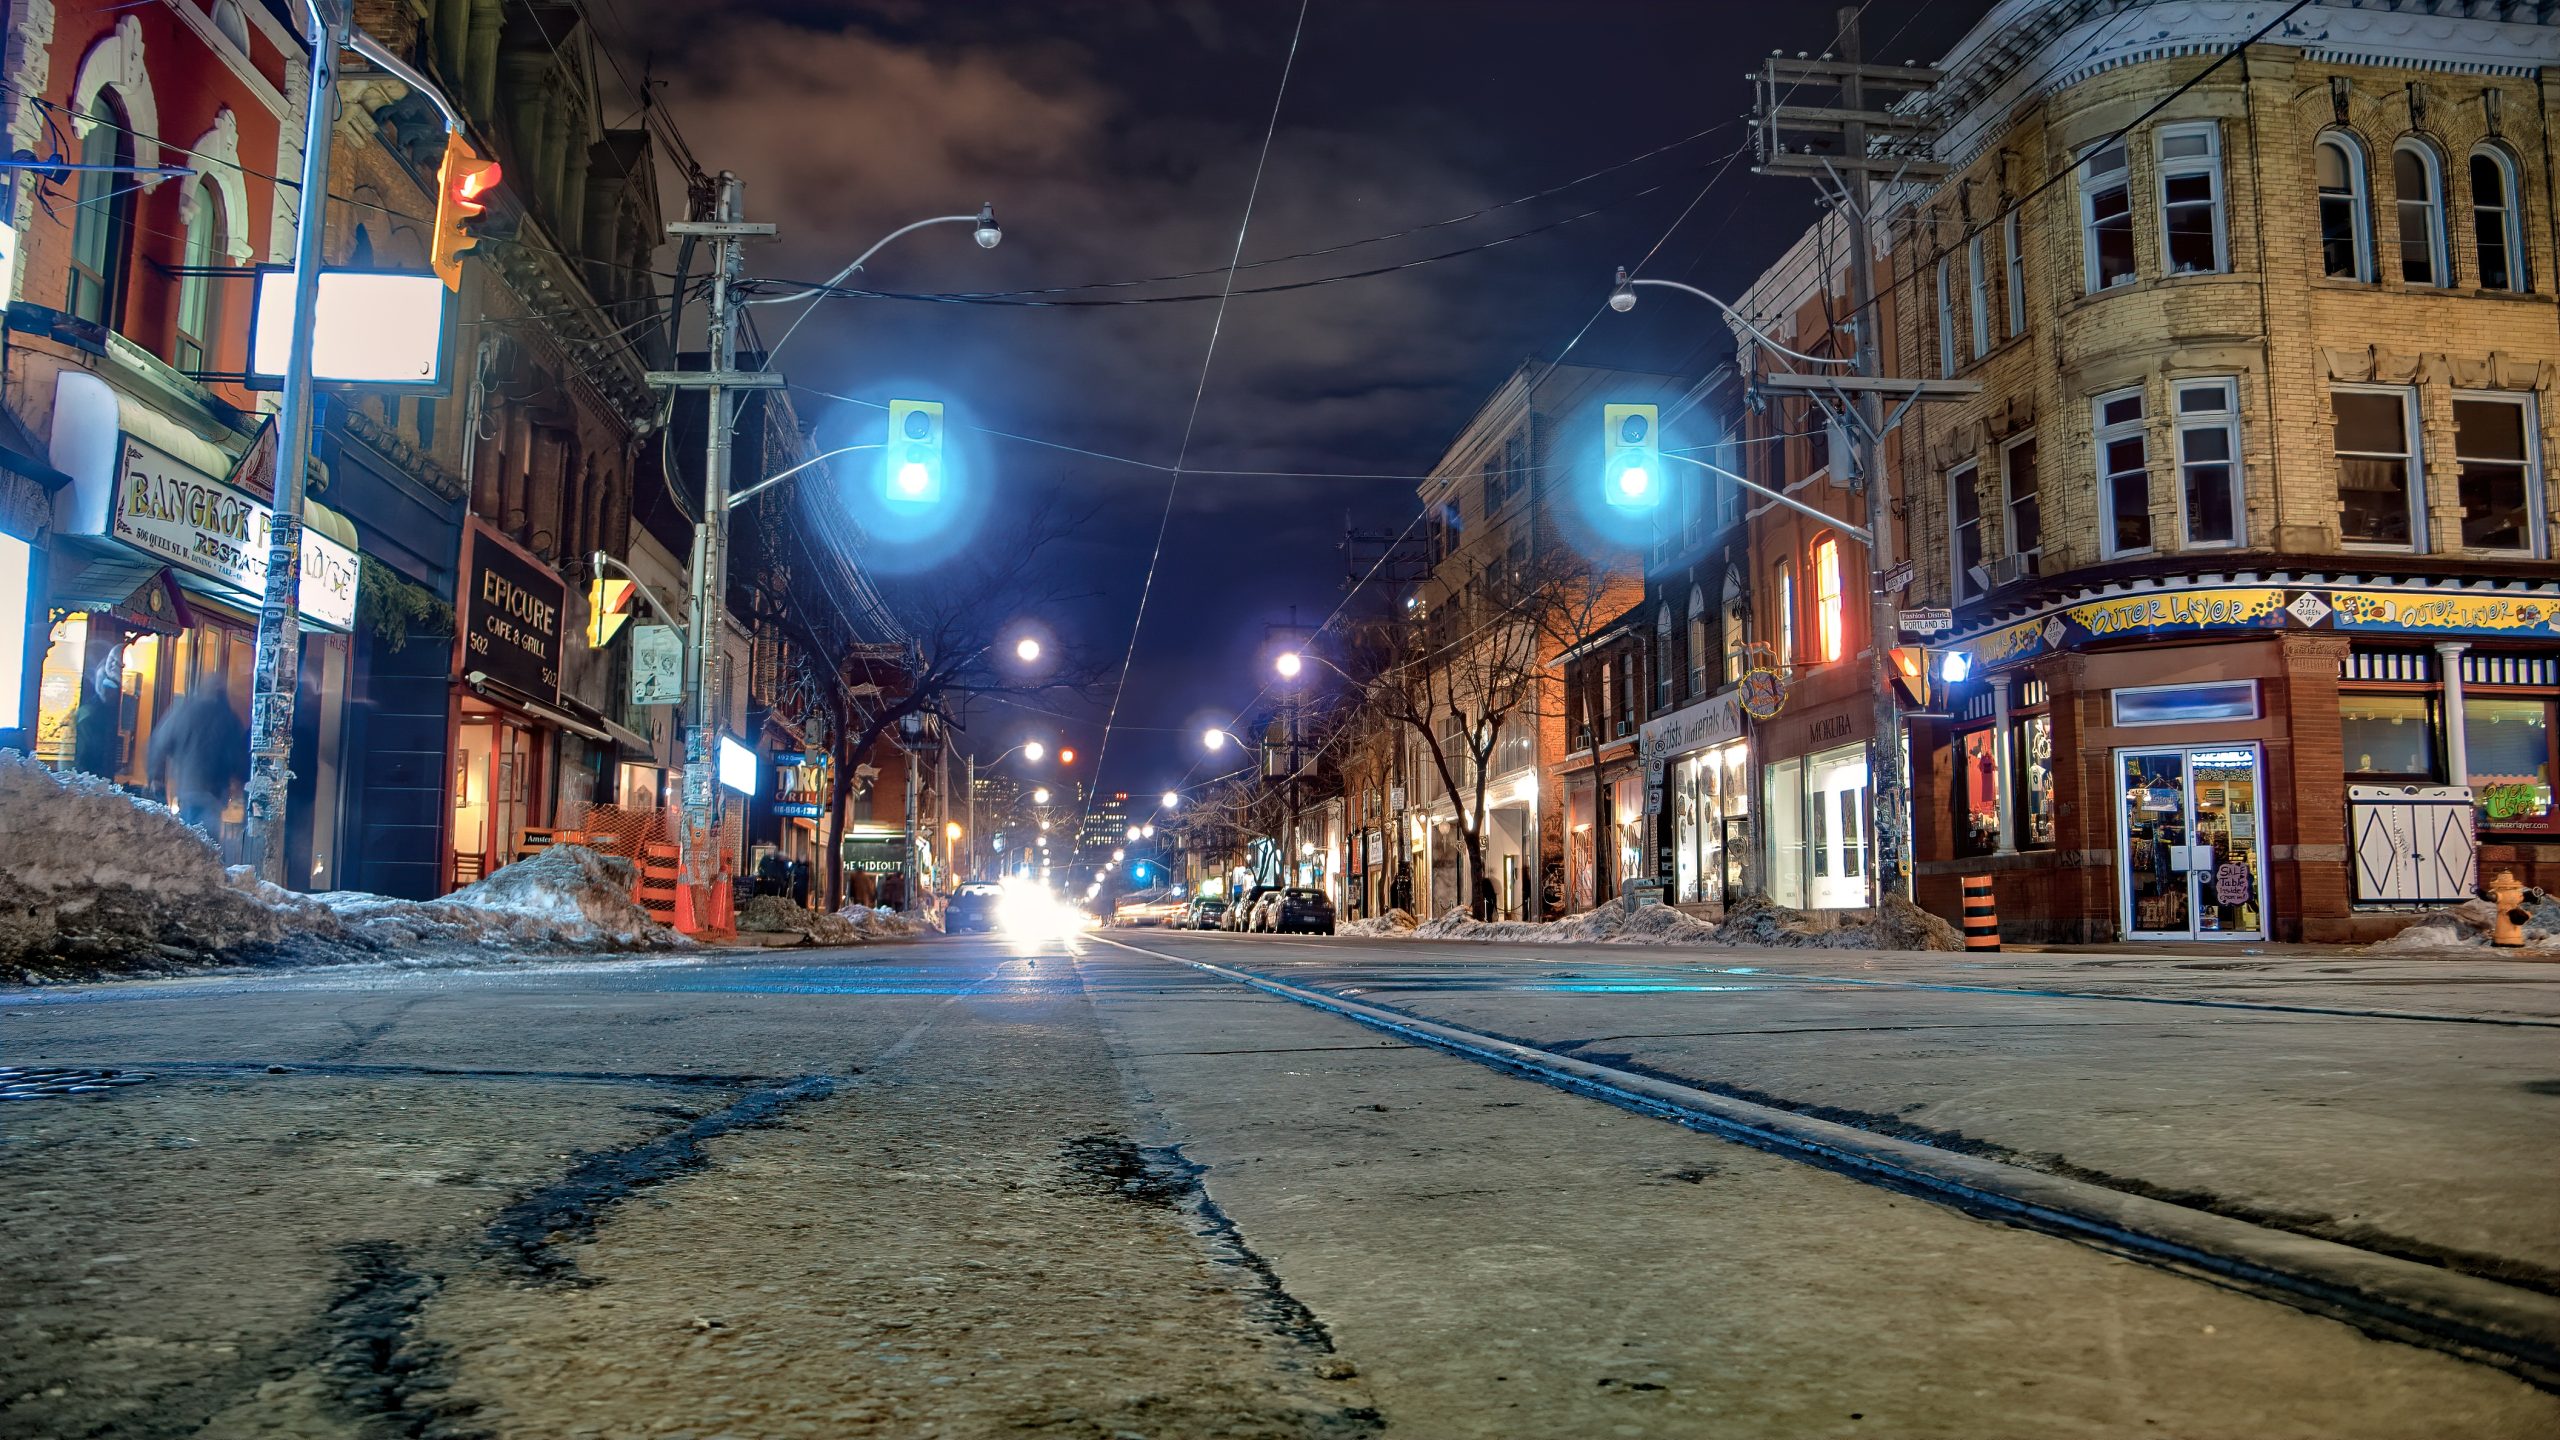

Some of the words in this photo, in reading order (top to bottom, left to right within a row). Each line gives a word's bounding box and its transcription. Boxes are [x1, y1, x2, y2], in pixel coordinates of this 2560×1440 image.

[127, 471, 252, 543] BANGKOK
[149, 532, 171, 552] QUEEN
[191, 554, 212, 569] DINING
[483, 567, 556, 636] EPICURE
[2299, 598, 2317, 609] 577
[1901, 612, 1926, 620] Fashion
[1927, 611, 1950, 619] District
[2296, 609, 2321, 617] QUEEN
[1904, 620, 1938, 629] PORTLAND
[1941, 620, 1949, 629] ST
[2049, 621, 2059, 632] 577
[470, 630, 489, 656] 502
[487, 615, 513, 643] CAFE
[512, 628, 521, 646] &
[521, 634, 547, 660] GRILL
[542, 667, 557, 688] 502
[1809, 714, 1852, 744] MOKUBA
[2476, 821, 2549, 830] www.outerlayer.com
[843, 861, 856, 871] HE
[858, 860, 902, 871] HIDEOUT
[2220, 866, 2245, 877] SALE
[2220, 877, 2245, 887] Table
